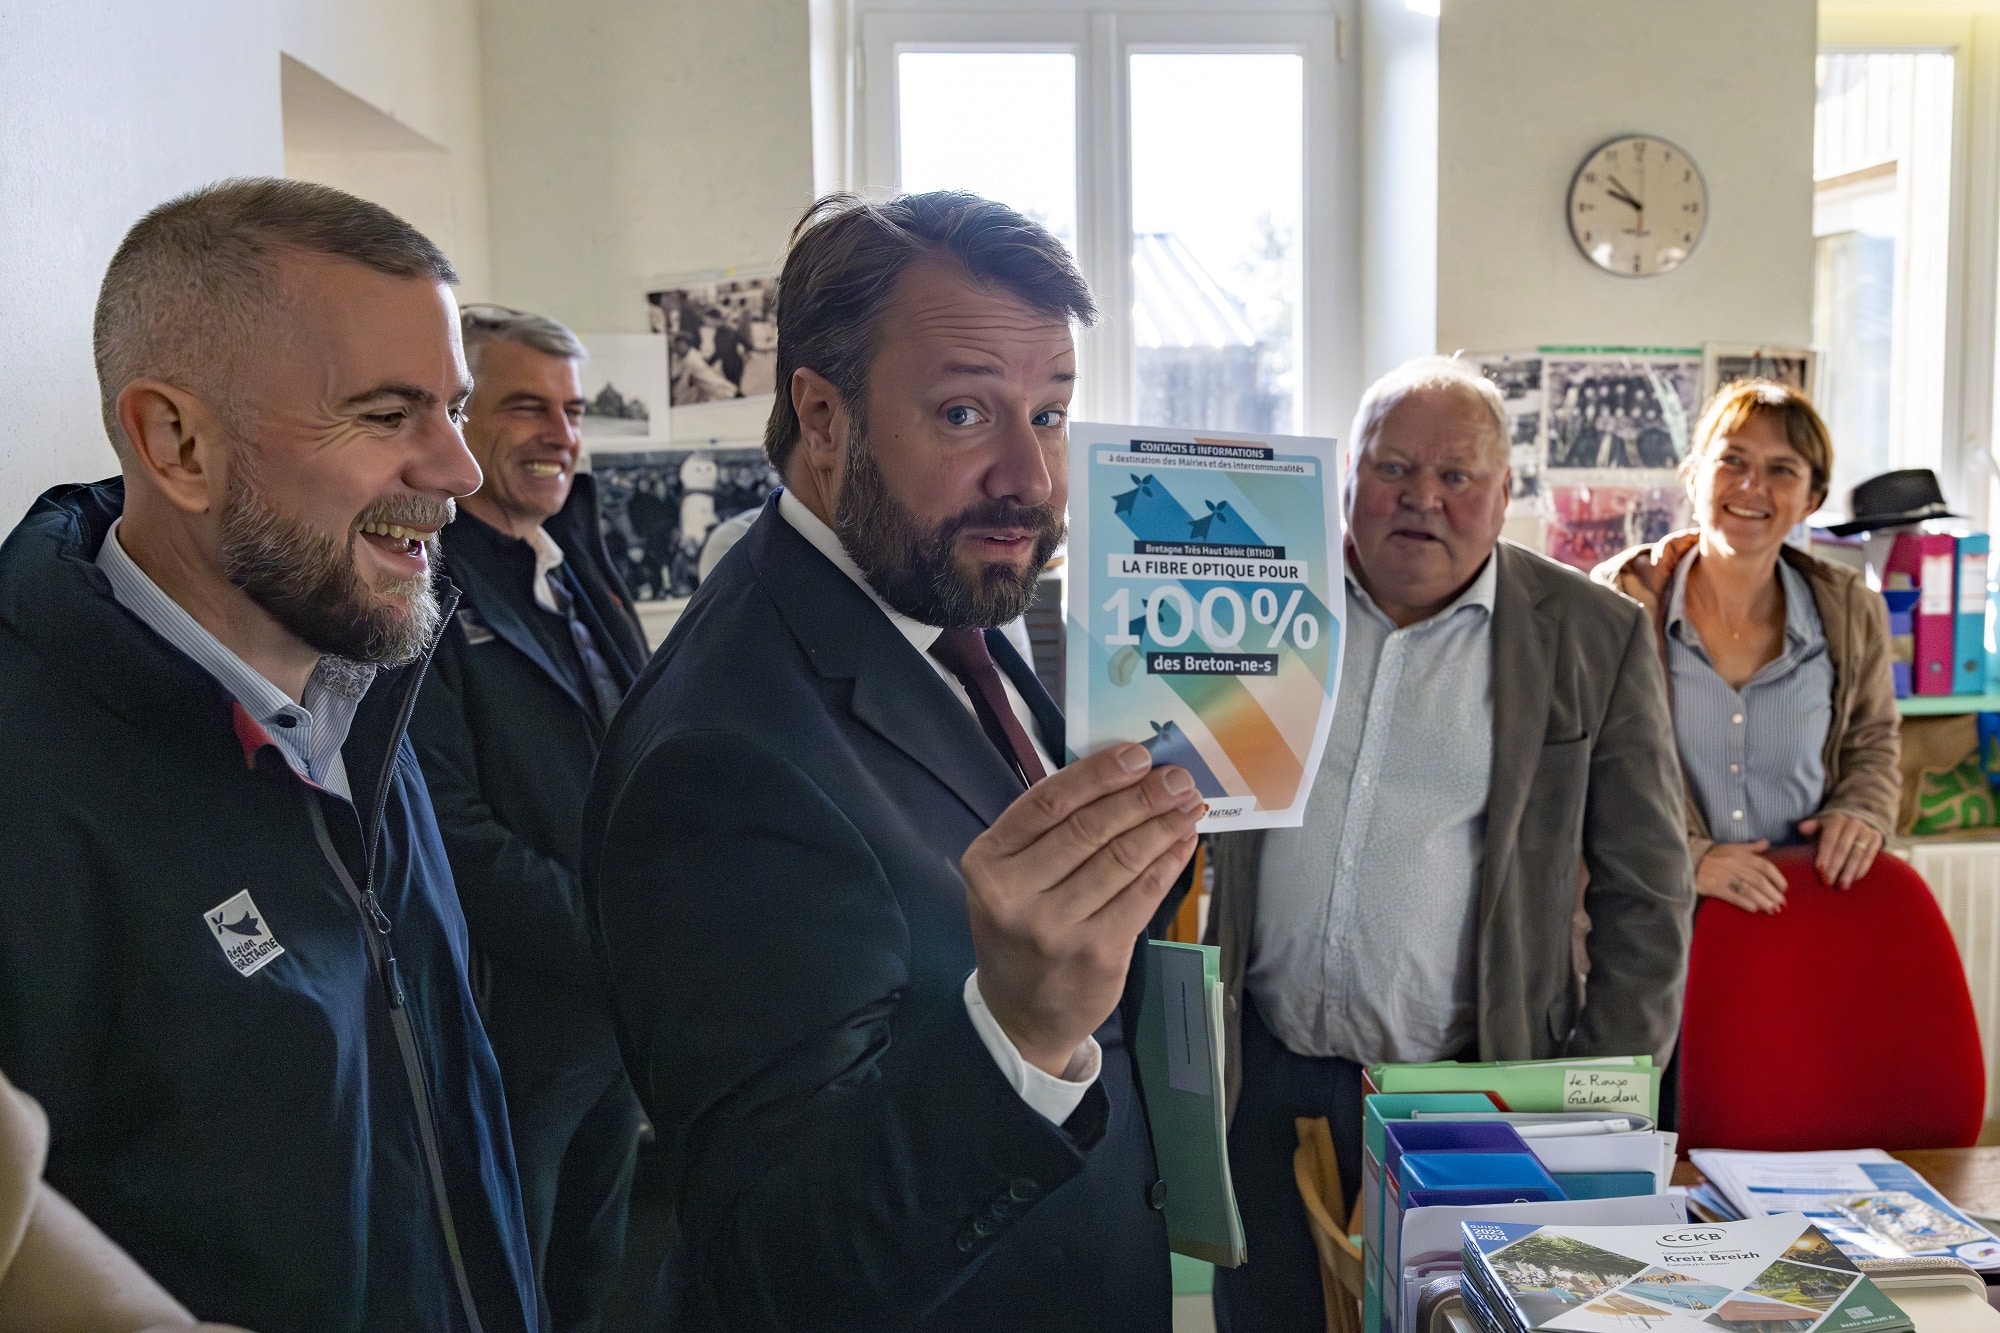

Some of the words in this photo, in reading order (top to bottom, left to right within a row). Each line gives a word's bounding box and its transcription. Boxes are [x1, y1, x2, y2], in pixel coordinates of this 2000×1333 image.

[1140, 442, 1187, 454] CONTACTS
[1188, 446, 1196, 454] &
[1197, 446, 1264, 459] INFORMATIONS
[1109, 454, 1114, 462] à
[1115, 455, 1160, 465] destination
[1162, 457, 1176, 465] des
[1178, 458, 1207, 467] Mairies
[1218, 461, 1231, 469] des
[1145, 544, 1182, 554] Bretagne
[1184, 545, 1201, 554] Très
[1202, 547, 1222, 556] Haut
[1223, 546, 1245, 557] Débit
[1246, 548, 1275, 559] (BTHD)
[1122, 560, 1141, 574] LA
[1145, 561, 1188, 575] FIBRE
[1192, 562, 1255, 578] OPTIQUE
[1259, 565, 1299, 579] POUR
[1102, 585, 1319, 650] 100%
[1154, 655, 1181, 671] des
[1184, 656, 1272, 672] Breton-ne-s
[226, 939, 257, 961] Région
[234, 937, 278, 970] BRETAGNE
[1472, 1228, 1505, 1236] 2023
[1476, 1234, 1509, 1242] 2024
[1662, 1233, 1722, 1242] CCKB
[1663, 1255, 1706, 1263] Kreiz
[1709, 1251, 1760, 1261] Breizh
